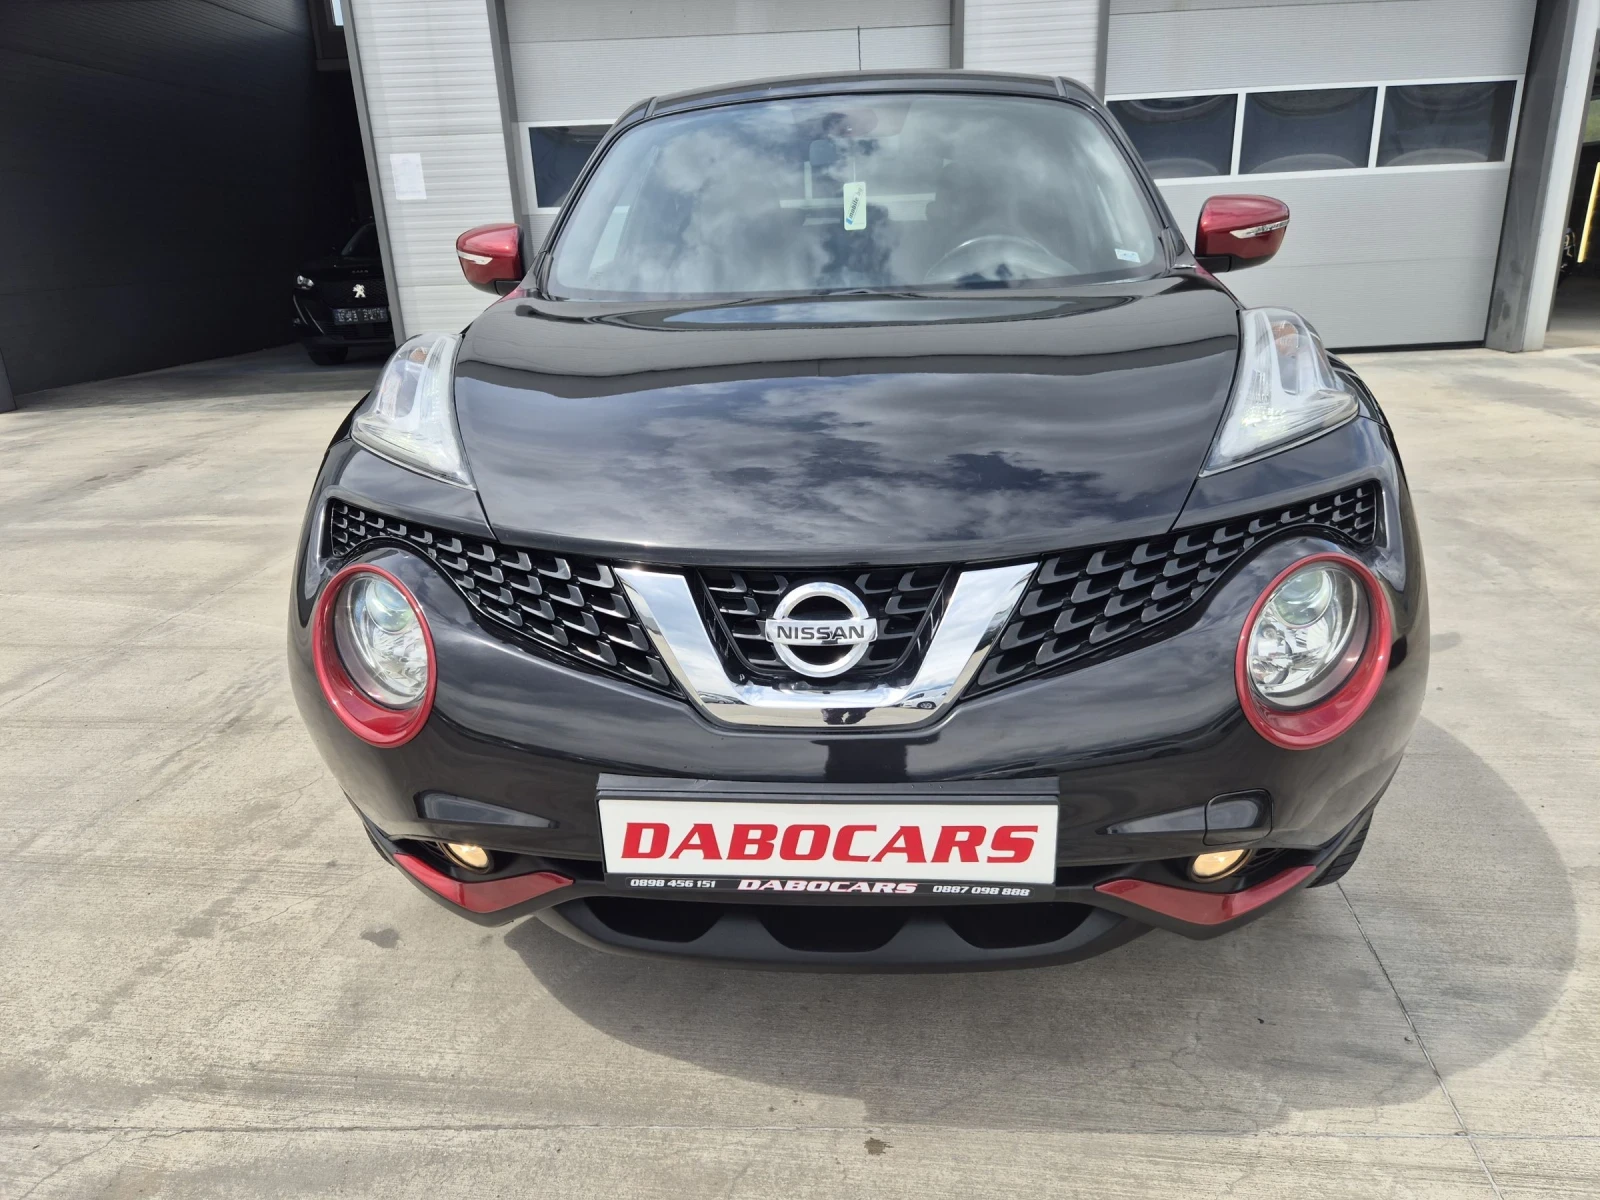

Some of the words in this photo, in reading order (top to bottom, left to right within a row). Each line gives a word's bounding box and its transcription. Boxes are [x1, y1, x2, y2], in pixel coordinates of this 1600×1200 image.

[777, 625, 865, 640] NISSAN
[621, 822, 1039, 863] DABOCARS
[630, 878, 664, 887] 0898
[667, 878, 694, 888] 456
[696, 880, 716, 888] 151
[737, 879, 918, 894] DABOCARS
[932, 885, 967, 894] 0887
[971, 886, 999, 895] 098
[1001, 887, 1030, 896] 888
